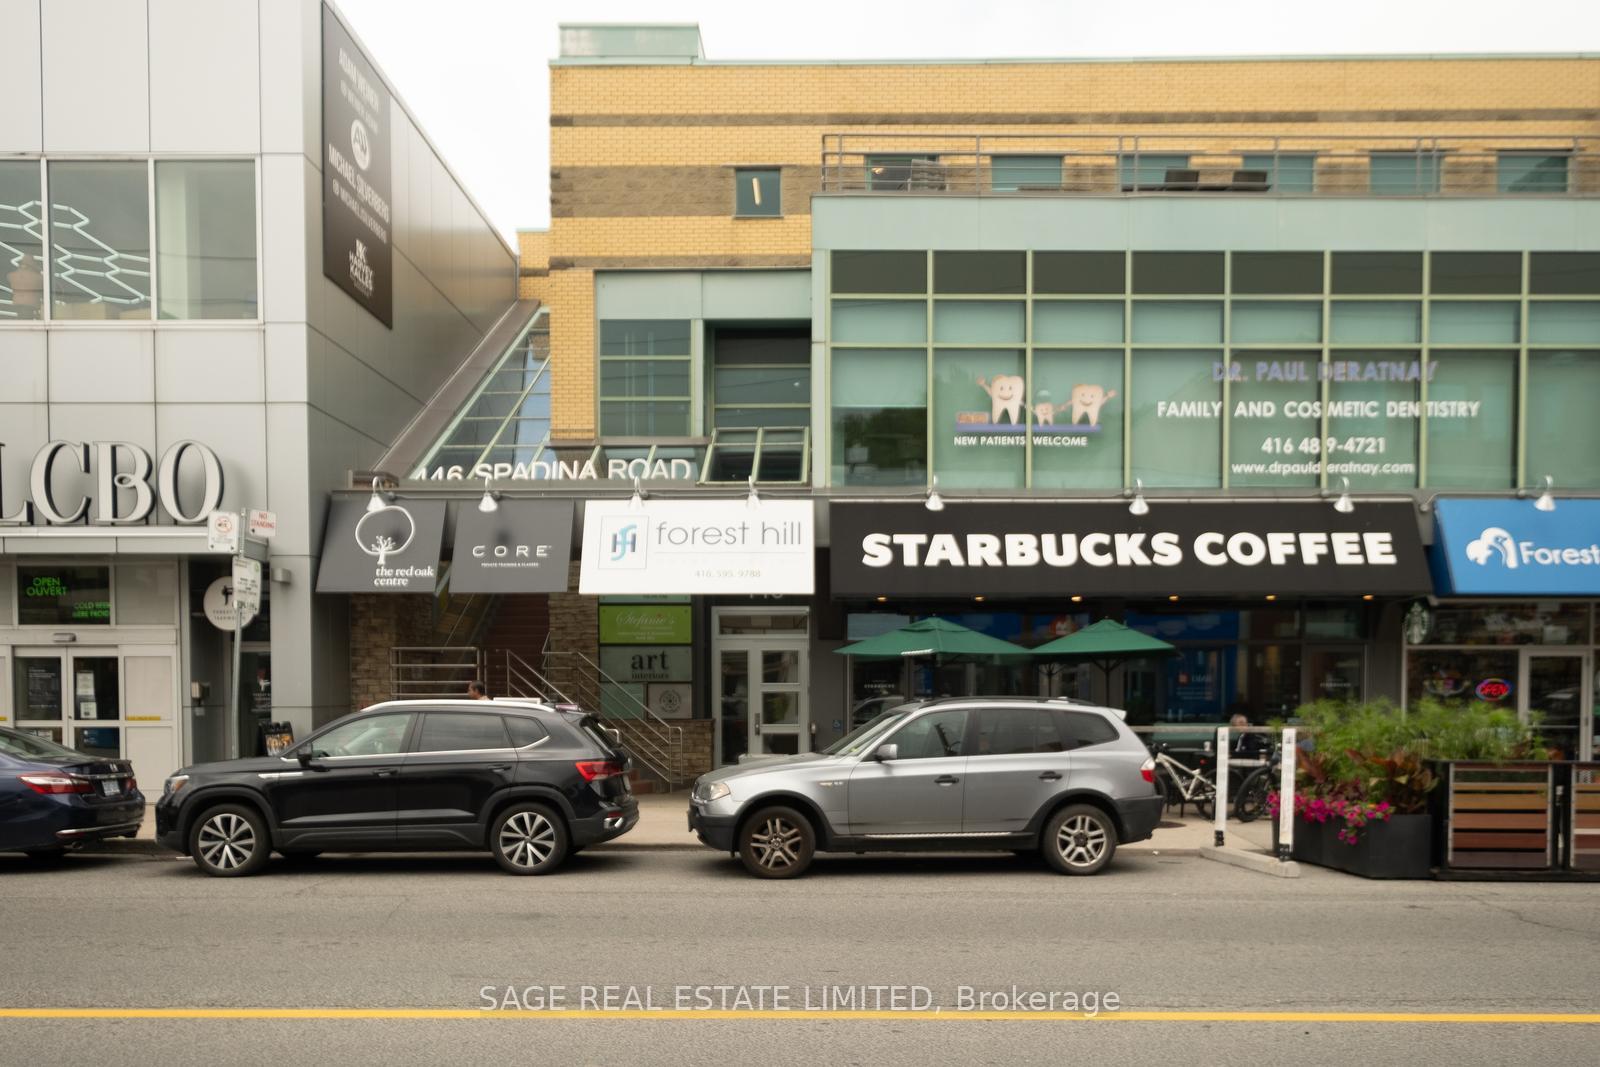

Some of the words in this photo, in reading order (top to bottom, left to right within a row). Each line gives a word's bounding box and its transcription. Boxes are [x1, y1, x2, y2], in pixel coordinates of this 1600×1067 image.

[328, 142, 355, 189] MICHAEL
[348, 250, 373, 281] HARVEY
[1212, 361, 1248, 381] DR.
[1256, 361, 1309, 381] PAUL
[1318, 361, 1438, 382] DERATNAY
[1157, 401, 1222, 417] FAMILY
[1234, 401, 1276, 417] AND
[1284, 401, 1379, 417] COSMETIC
[1386, 401, 1480, 418] DENTISTRY
[954, 436, 976, 446] NEW
[980, 436, 1026, 446] PATIENTS
[1033, 436, 1088, 446] WELCOME
[1261, 437, 1294, 454] 416
[1298, 437, 1386, 454] 489-4721
[475, 460, 598, 480] SPADINA
[608, 458, 691, 480] ROAD
[259, 512, 268, 520] NO
[656, 521, 750, 546] forest
[761, 521, 801, 546] hill
[472, 545, 549, 557] CORE
[861, 532, 1183, 567] STARBUCKS
[1193, 531, 1397, 566] COFFEE
[375, 565, 393, 577] the
[395, 565, 414, 577] red
[414, 565, 434, 577] oak
[33, 577, 60, 586] OPEN
[373, 577, 409, 587] centre
[26, 587, 67, 596] OUVERT
[631, 650, 670, 670] art
[1479, 683, 1509, 696] OPEN
